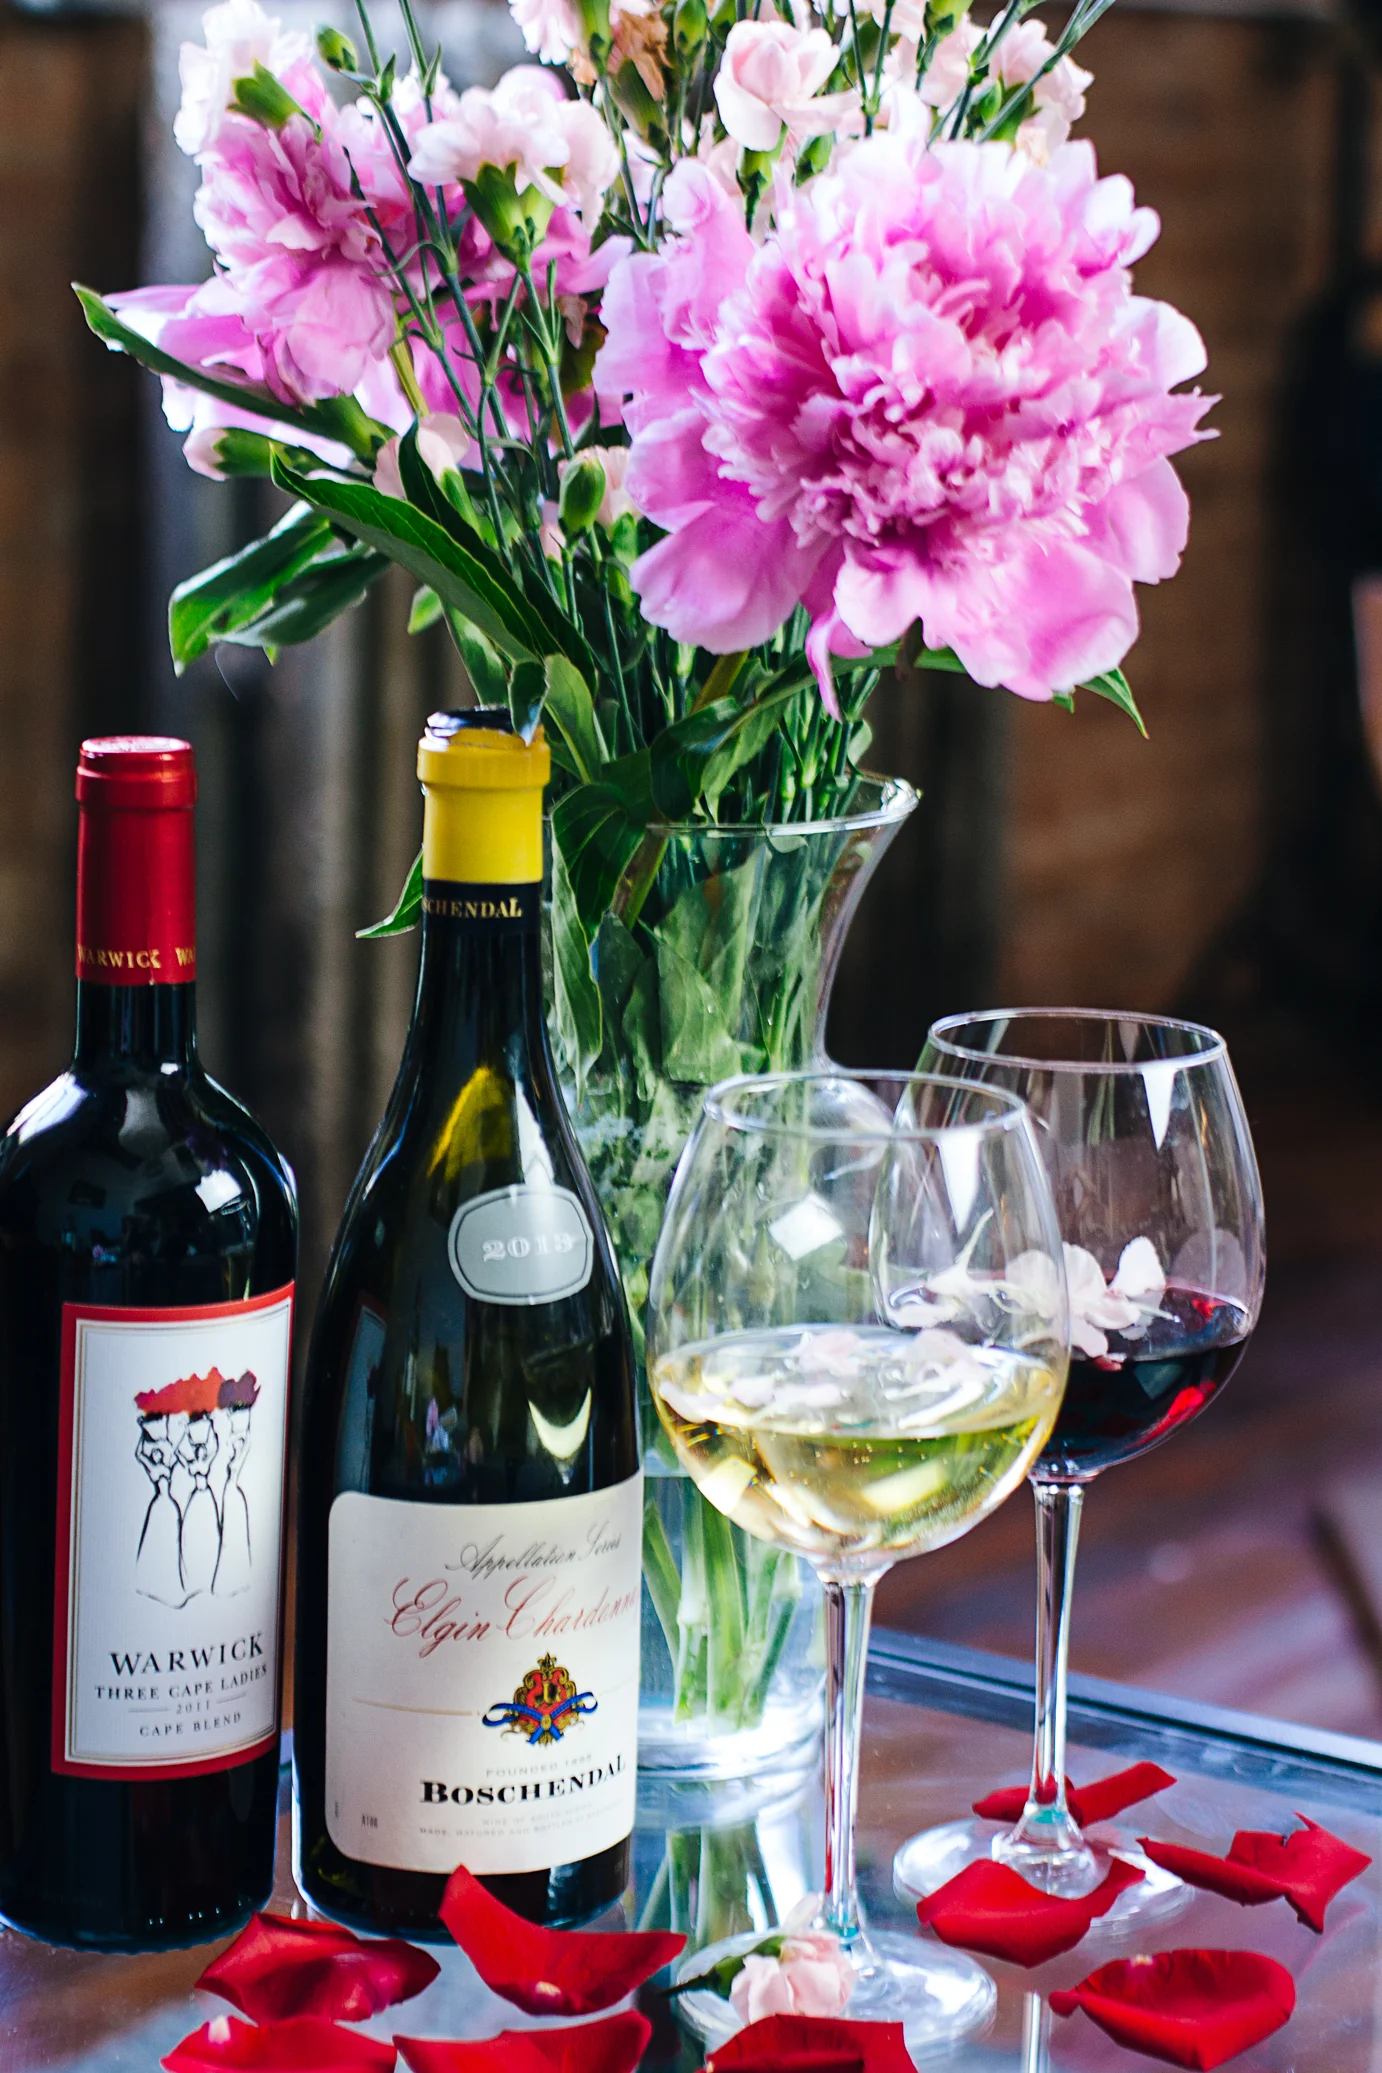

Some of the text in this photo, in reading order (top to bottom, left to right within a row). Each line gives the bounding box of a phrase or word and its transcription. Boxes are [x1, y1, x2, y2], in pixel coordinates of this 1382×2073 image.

[445, 1520, 622, 1580] Appellation Series
[384, 1575, 638, 1658] Elgin Chardonna
[109, 1632, 264, 1676] WARWICK
[94, 1662, 268, 1701] THREE CAPE LADIES
[139, 1711, 242, 1737] CAPE BLEND
[176, 1699, 211, 1715] 2011
[419, 1752, 626, 1805] BOSCHENDAL
